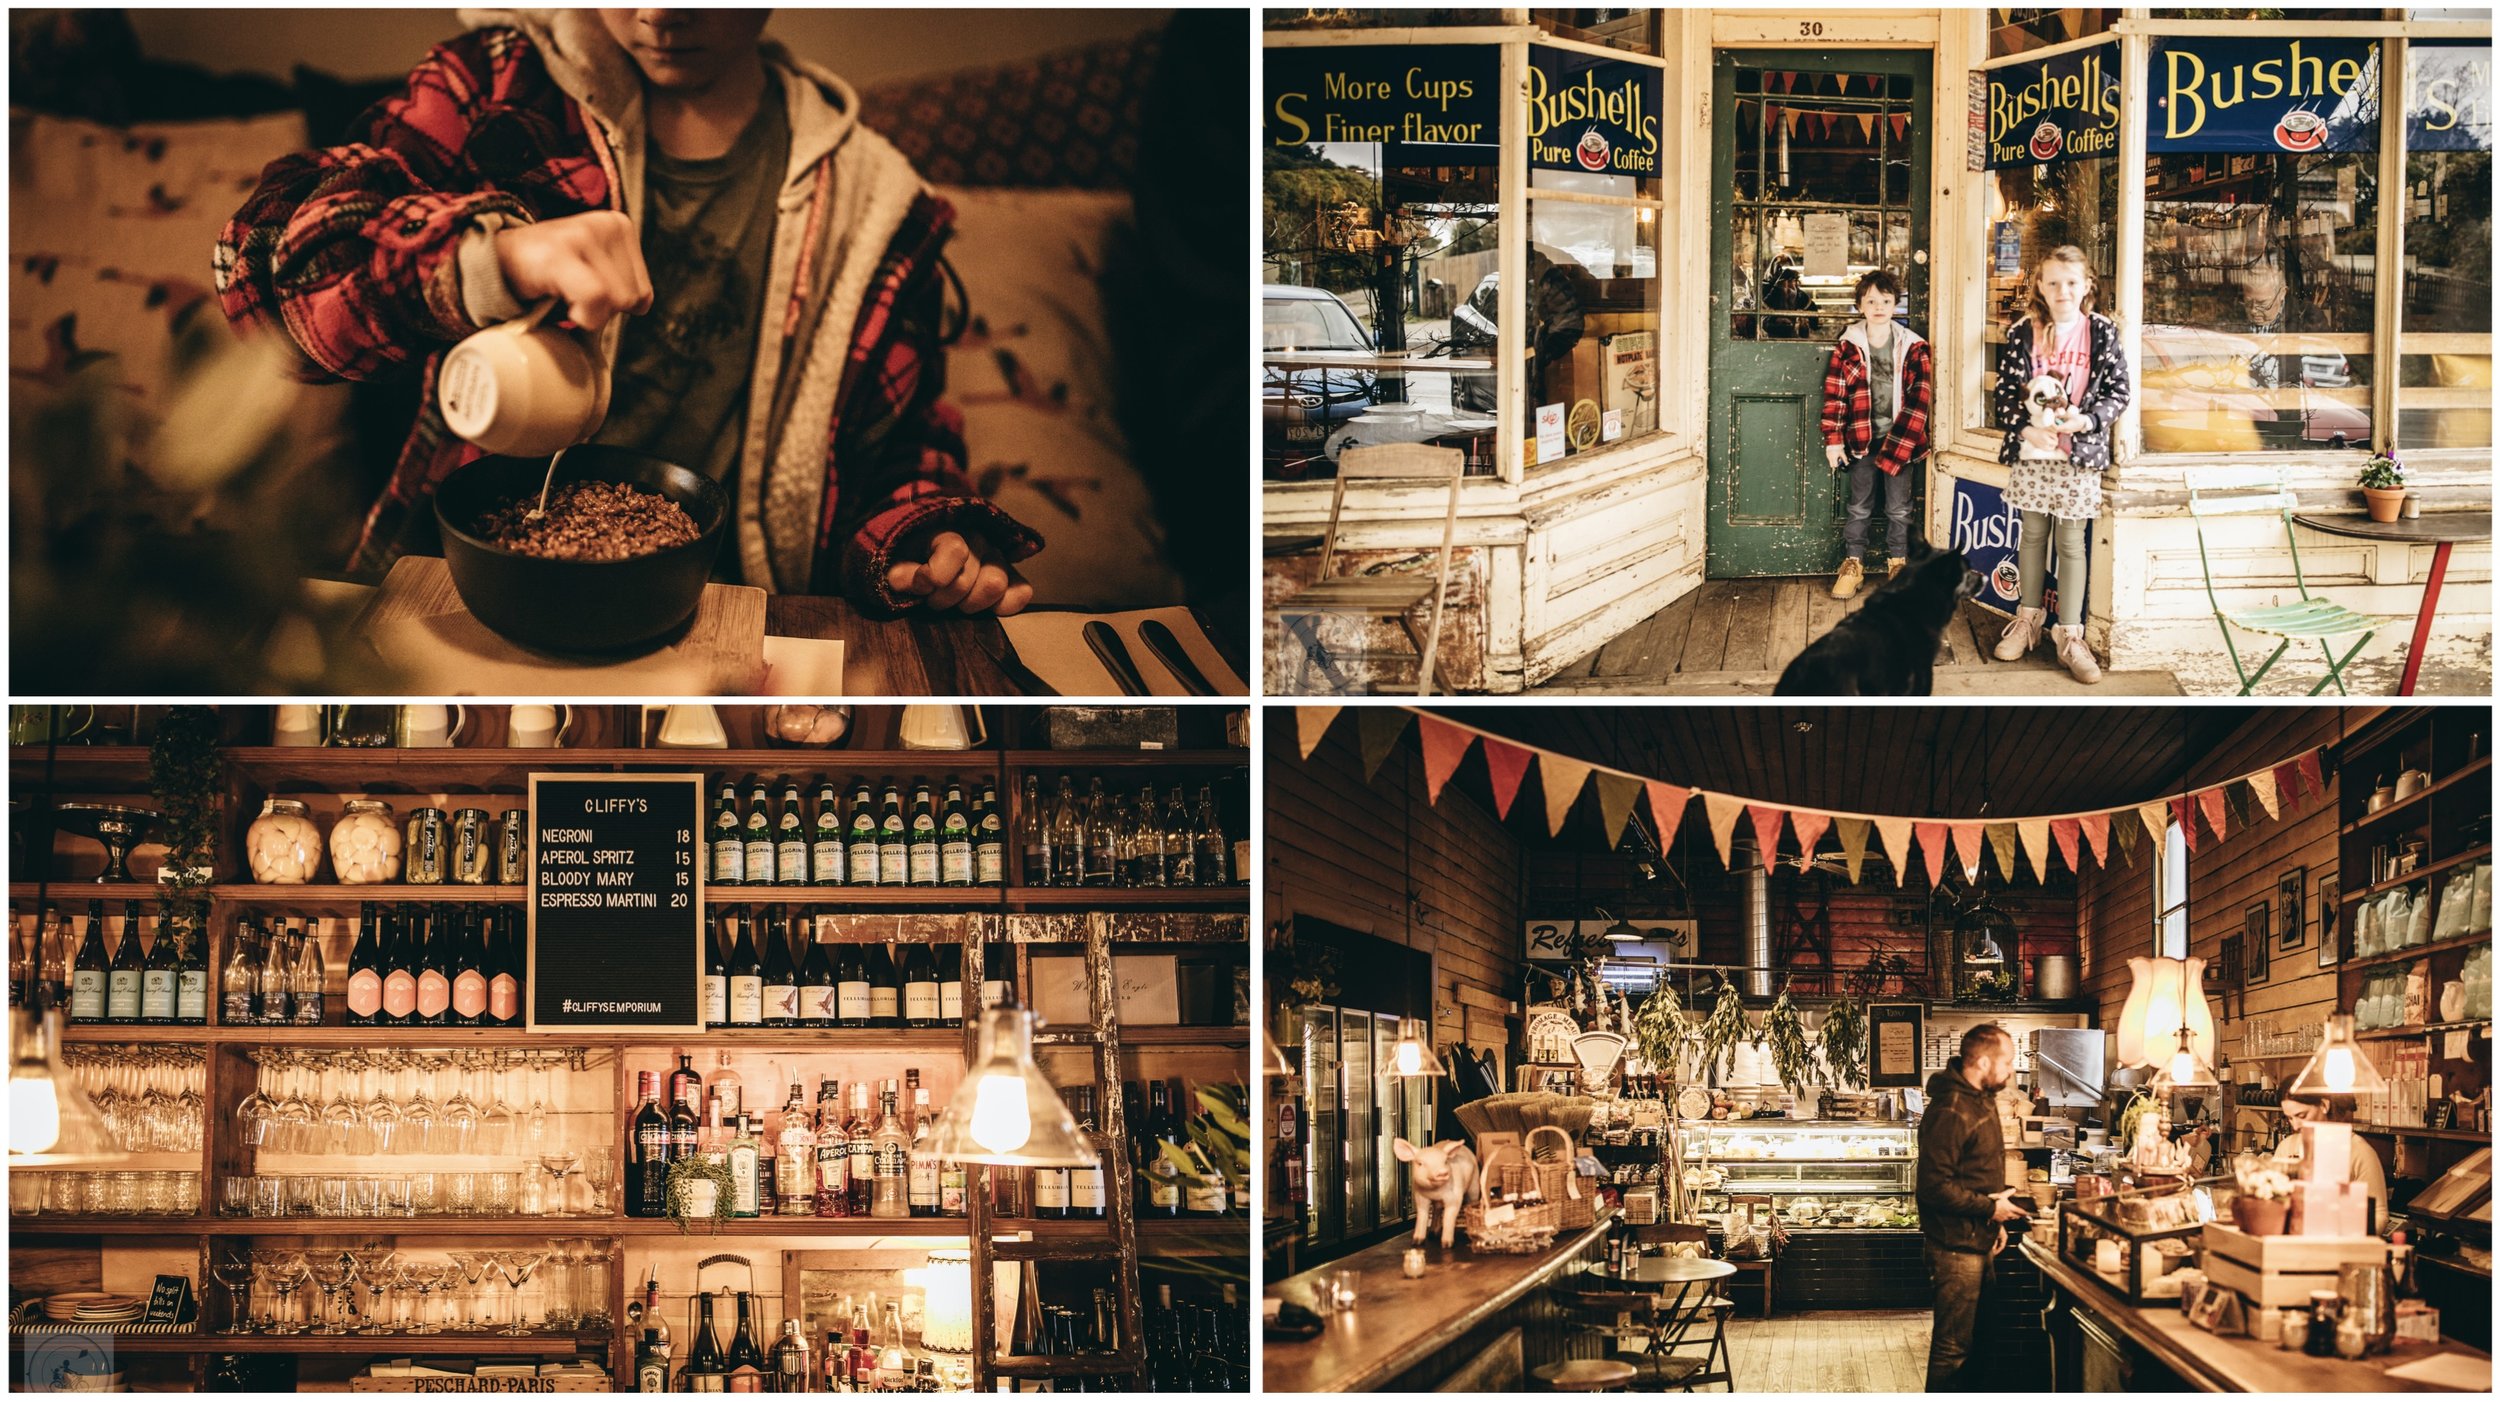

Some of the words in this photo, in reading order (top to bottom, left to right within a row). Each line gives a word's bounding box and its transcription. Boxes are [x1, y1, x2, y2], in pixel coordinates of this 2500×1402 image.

[1800, 21, 1823, 36] 30
[1324, 72, 1391, 100] More
[1405, 67, 1473, 112] Cups
[1989, 55, 2120, 143] Bushells
[1527, 66, 1658, 155] Bushells
[1325, 113, 1395, 143] Finer
[1401, 112, 1482, 143] flavor
[1993, 142, 2025, 163] Pure
[2066, 127, 2115, 154] Coffee
[1532, 137, 1572, 164] Pure
[1614, 147, 1654, 172] Coffee
[584, 798, 648, 813] CLIFFY'S
[542, 829, 593, 843] NEGRONI
[676, 829, 690, 844] 18
[541, 851, 589, 865] APEROL
[593, 850, 634, 864] SPRITZ
[675, 851, 690, 866] 15
[541, 872, 591, 886] BLOODY
[597, 872, 634, 886] MARY
[676, 872, 689, 886] 15
[541, 893, 602, 907] ESPRESSO
[606, 893, 657, 907] MARTINI
[671, 893, 688, 907] 20
[562, 999, 662, 1013] #CLIFFYSEMPORIUM
[1530, 1013, 1558, 1035] FROMAGE
[819, 1148, 847, 1160] APEROL
[911, 1159, 937, 1170] PIMM'S
[156, 1282, 166, 1294] No
